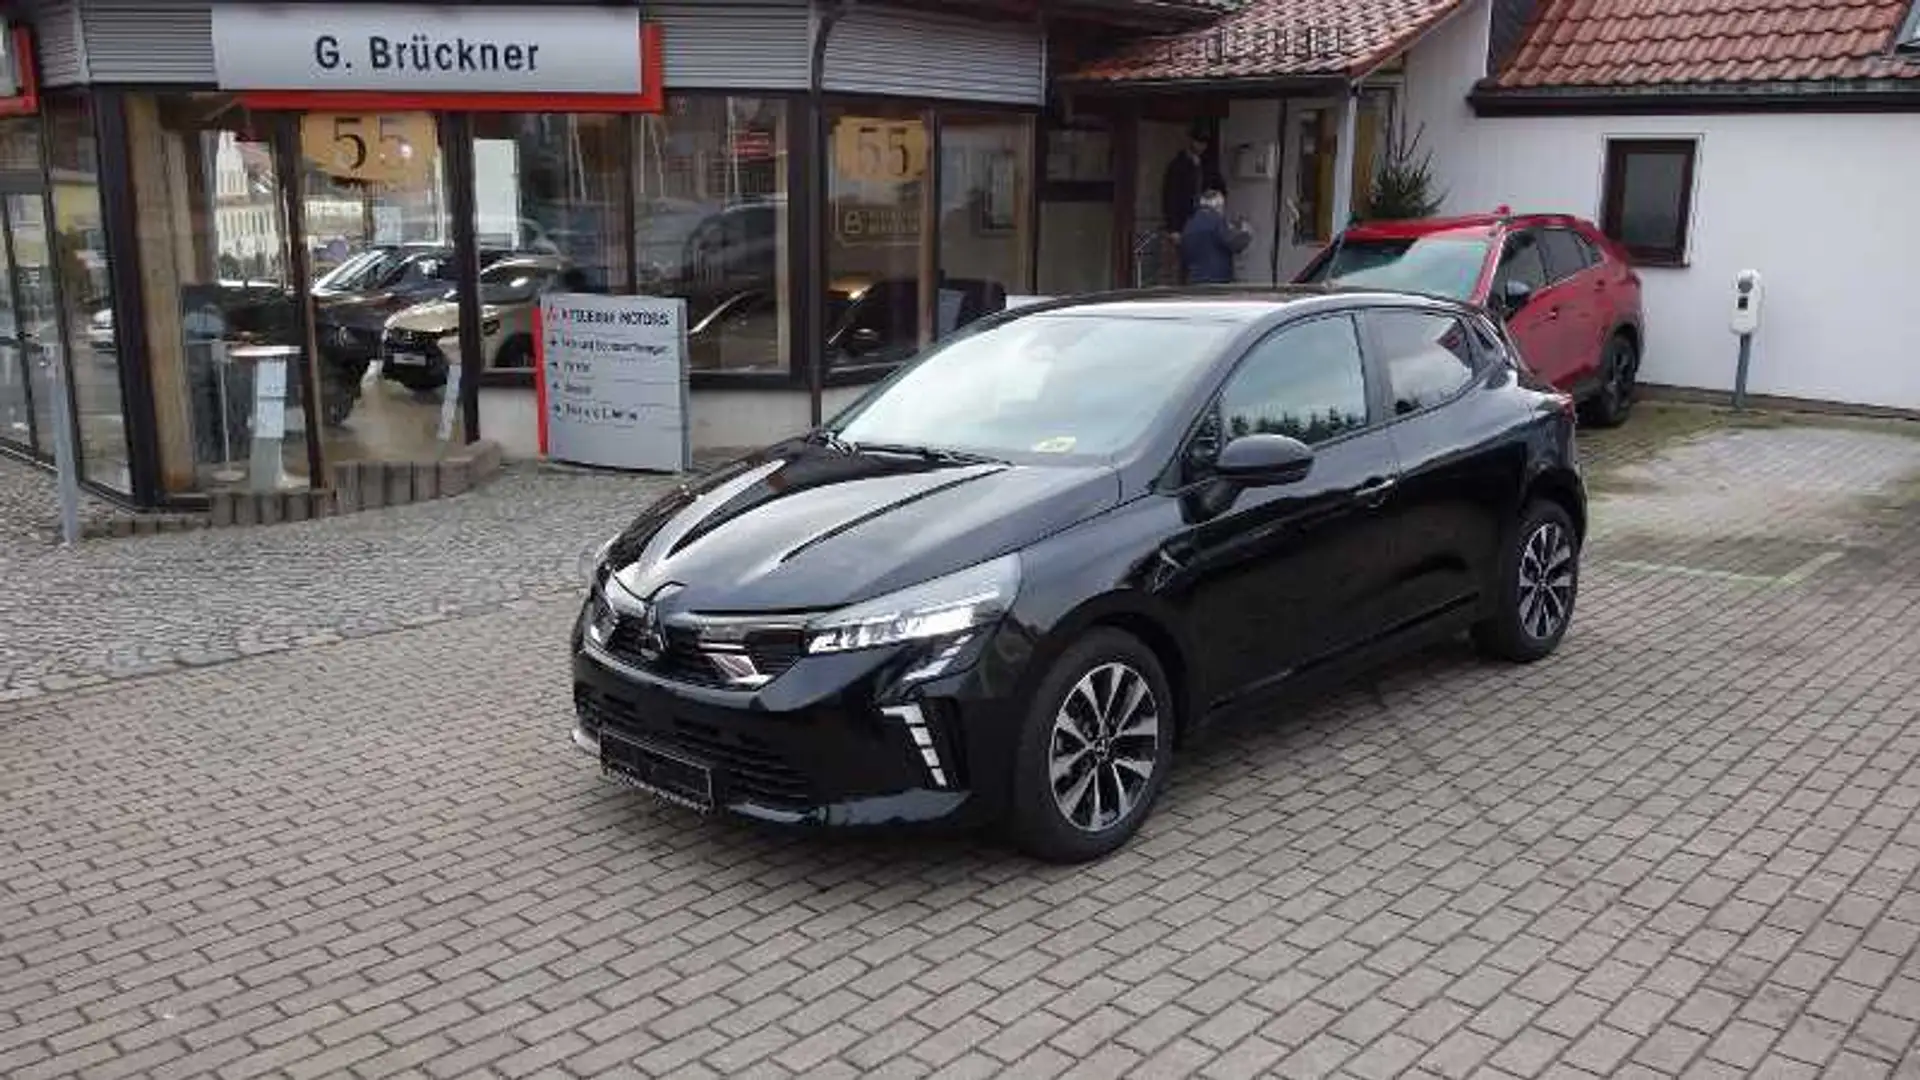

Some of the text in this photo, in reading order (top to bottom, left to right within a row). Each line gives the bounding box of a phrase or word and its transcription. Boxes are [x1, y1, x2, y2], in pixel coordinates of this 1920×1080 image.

[315, 34, 539, 71] G. Brückner
[333, 116, 412, 171] 55
[858, 126, 909, 177] 55
